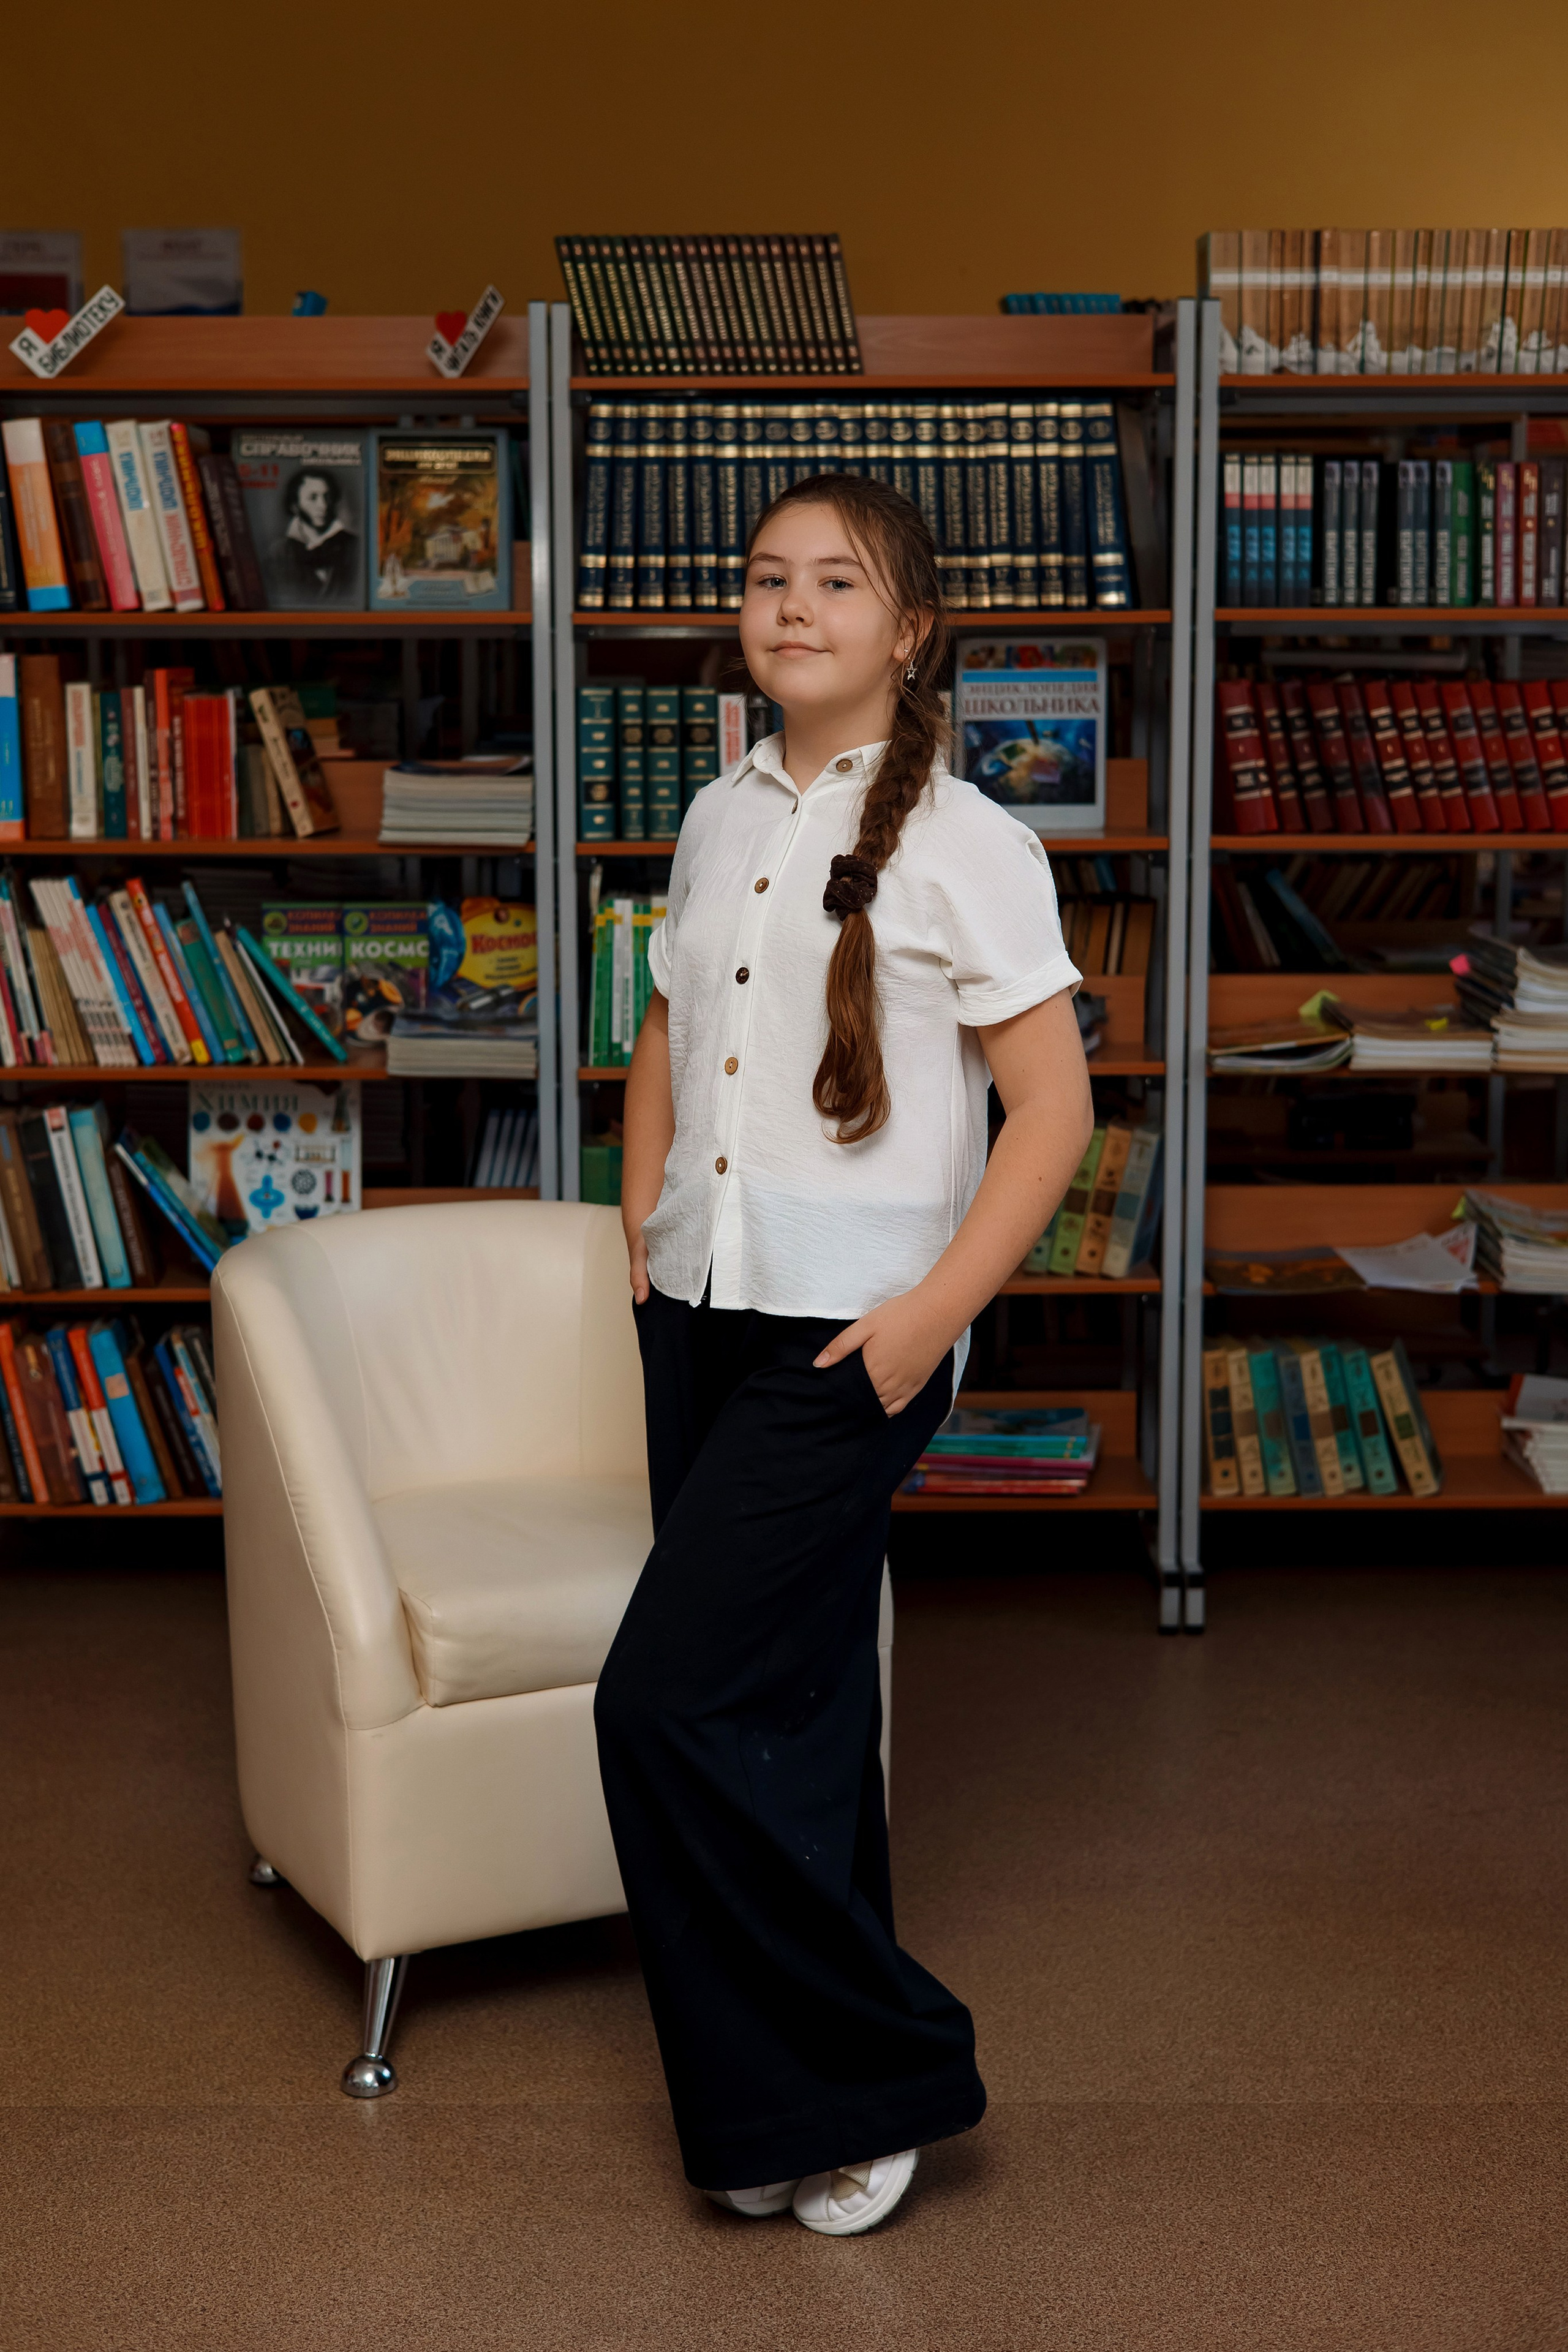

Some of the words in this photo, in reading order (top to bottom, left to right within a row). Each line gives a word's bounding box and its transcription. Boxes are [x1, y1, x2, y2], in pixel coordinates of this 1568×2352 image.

[38, 291, 119, 374] БИБЛИОТЕКУ
[18, 336, 38, 359] Я
[240, 442, 361, 458] СПРАВОЧНИК
[964, 698, 1101, 714] ШКОЛЬНИКА
